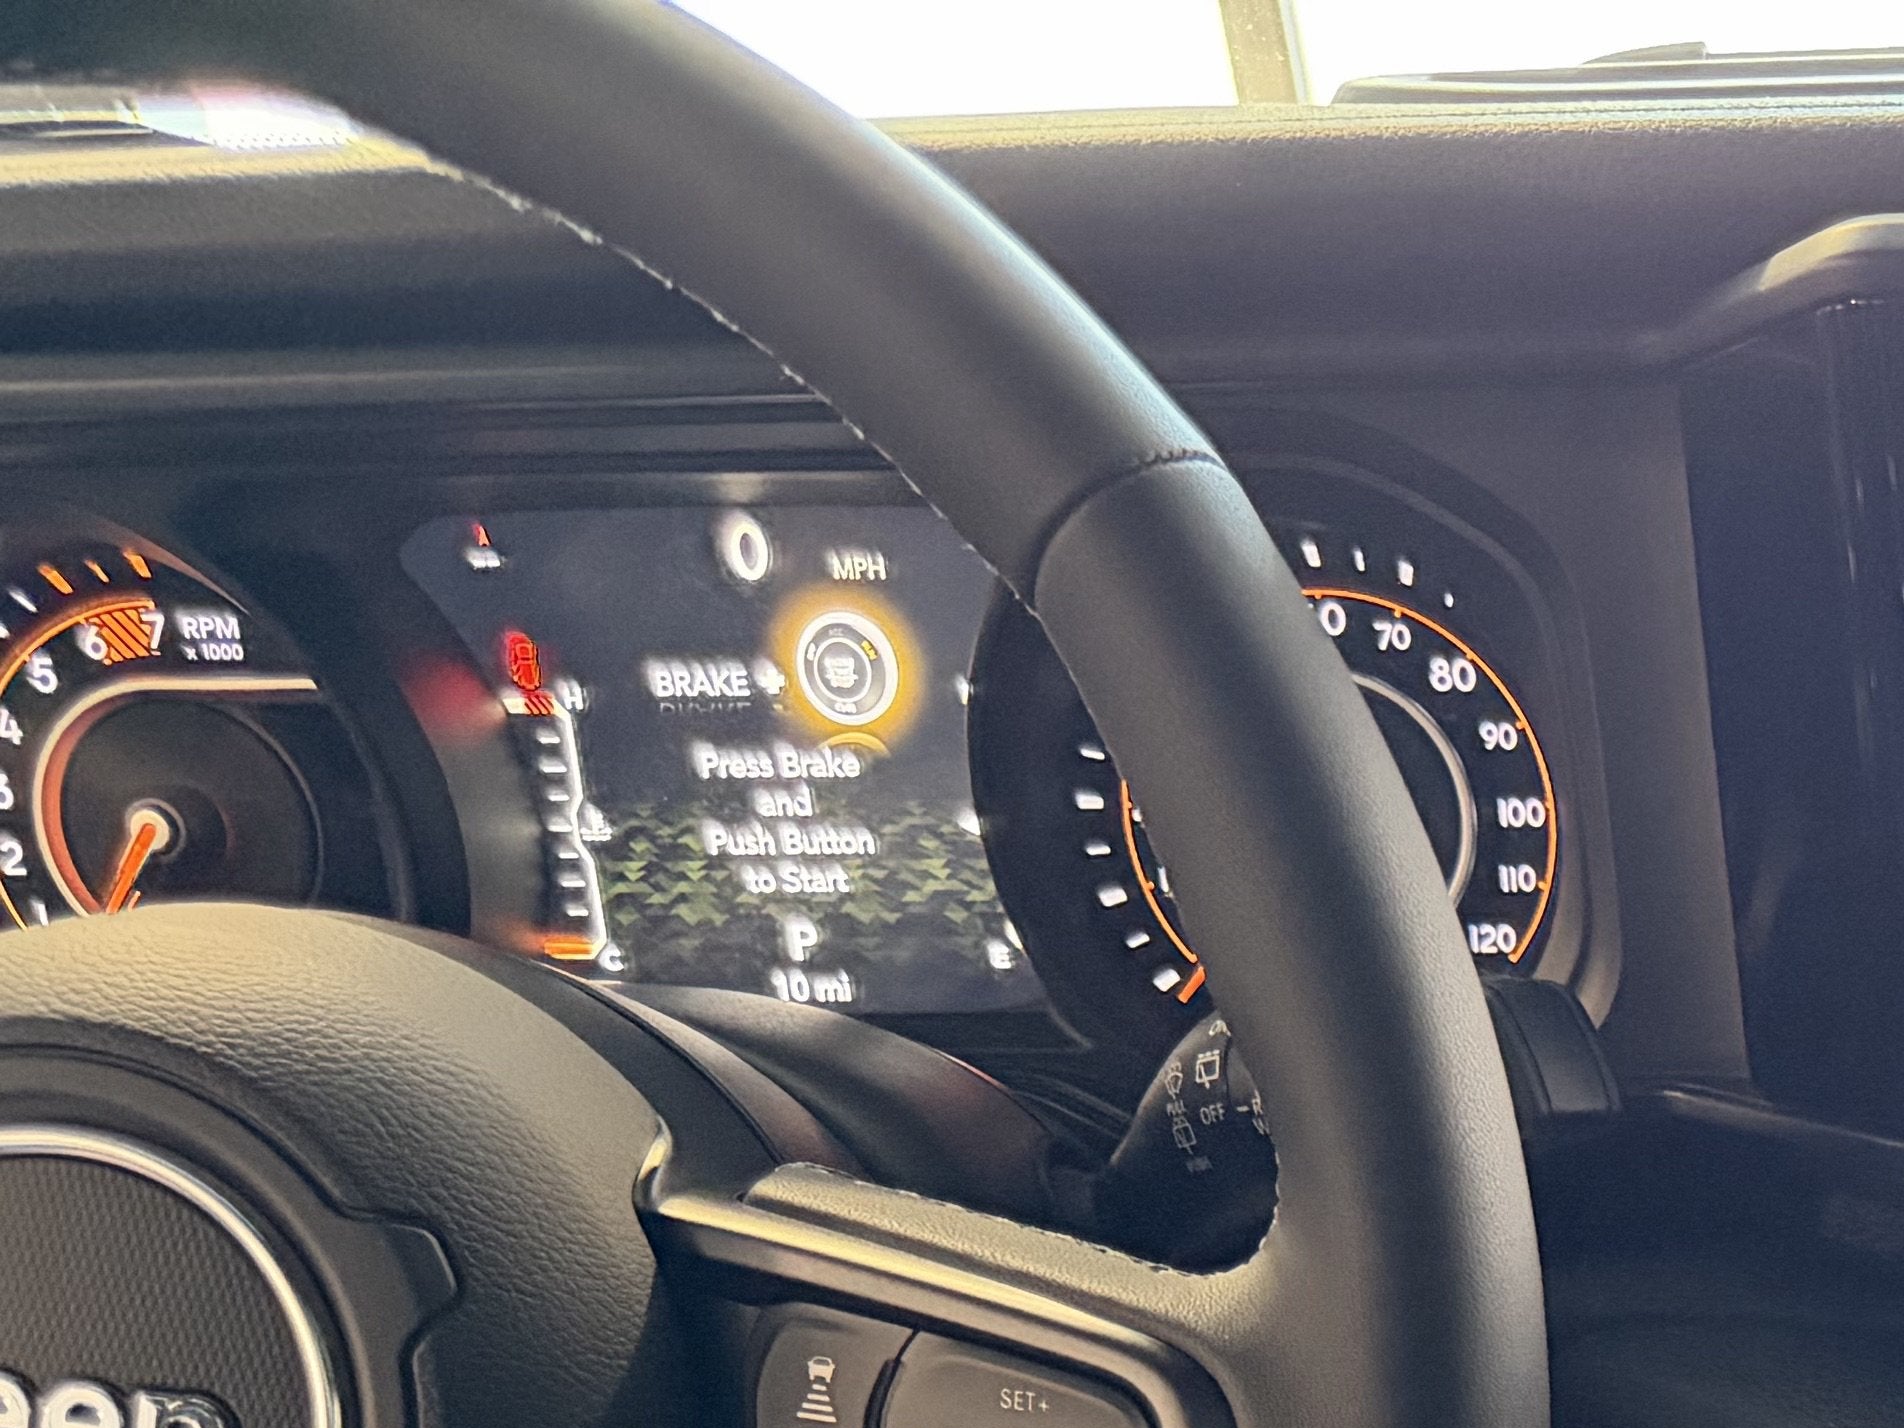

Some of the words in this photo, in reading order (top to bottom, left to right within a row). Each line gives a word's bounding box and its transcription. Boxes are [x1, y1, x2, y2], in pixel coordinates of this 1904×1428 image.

[831, 553, 887, 580] MPH
[141, 611, 164, 650] 7
[182, 614, 241, 642] RPM
[1374, 622, 1412, 650] 70
[199, 642, 244, 662] 1000
[26, 655, 58, 694] 5
[655, 666, 750, 698] BRAKE
[1429, 656, 1476, 692] 80
[1479, 720, 1517, 750] 90
[699, 750, 774, 779] Press
[784, 750, 861, 779] Brake
[759, 786, 813, 818] and
[1498, 798, 1545, 827] 100
[709, 828, 776, 856] Push
[784, 828, 876, 856] Button
[0, 840, 27, 876] 2
[747, 869, 777, 893] to
[783, 868, 851, 893] Start
[1499, 864, 1536, 893] 110
[789, 921, 819, 961] P
[1469, 923, 1516, 953] 120
[774, 970, 809, 1003] 10
[813, 970, 853, 1003] mi
[1200, 1103, 1226, 1125] OFF
